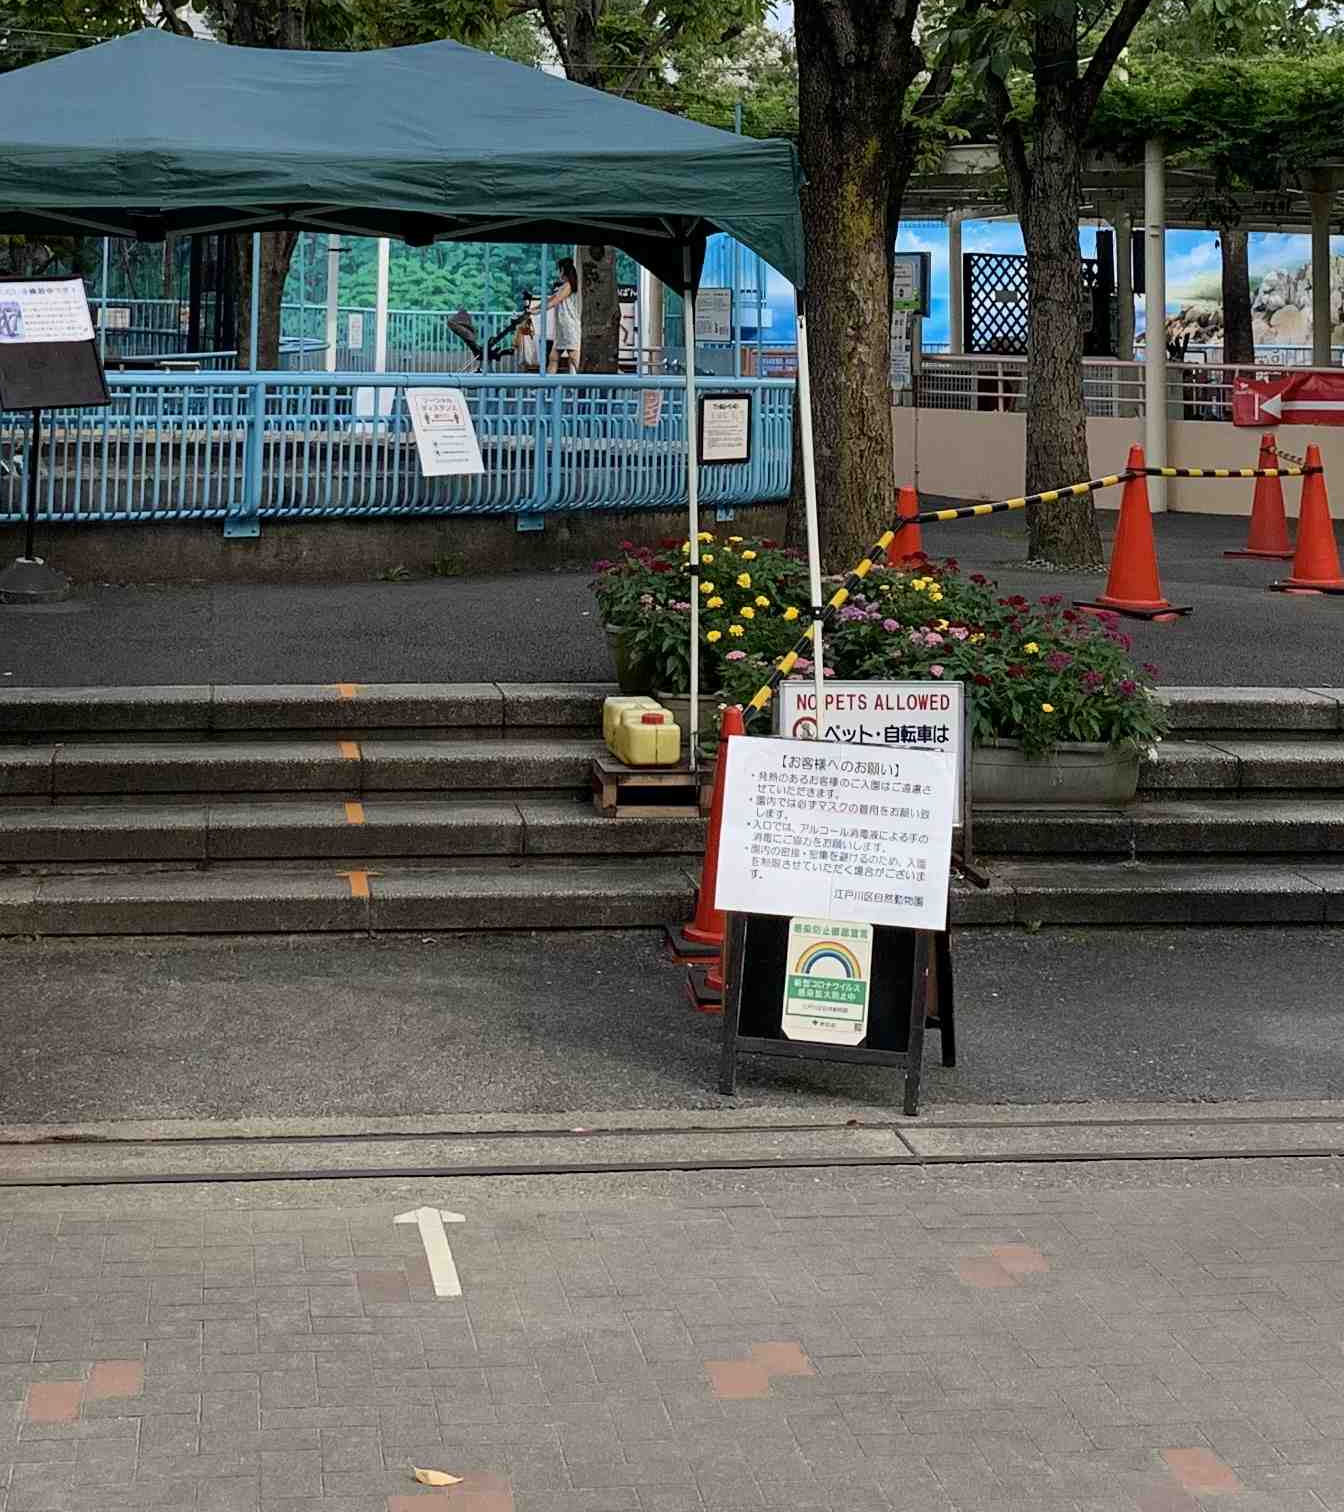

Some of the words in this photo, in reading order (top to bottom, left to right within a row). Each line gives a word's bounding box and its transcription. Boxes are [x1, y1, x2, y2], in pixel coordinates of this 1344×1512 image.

[825, 694, 867, 710] PETS
[874, 694, 950, 710] ALLOWED
[825, 724, 949, 744] ペット・自転車は
[782, 755, 900, 778] 【お客様へのお願い】
[756, 807, 789, 820] します。
[833, 887, 924, 907] 江戸川区自然動物園
